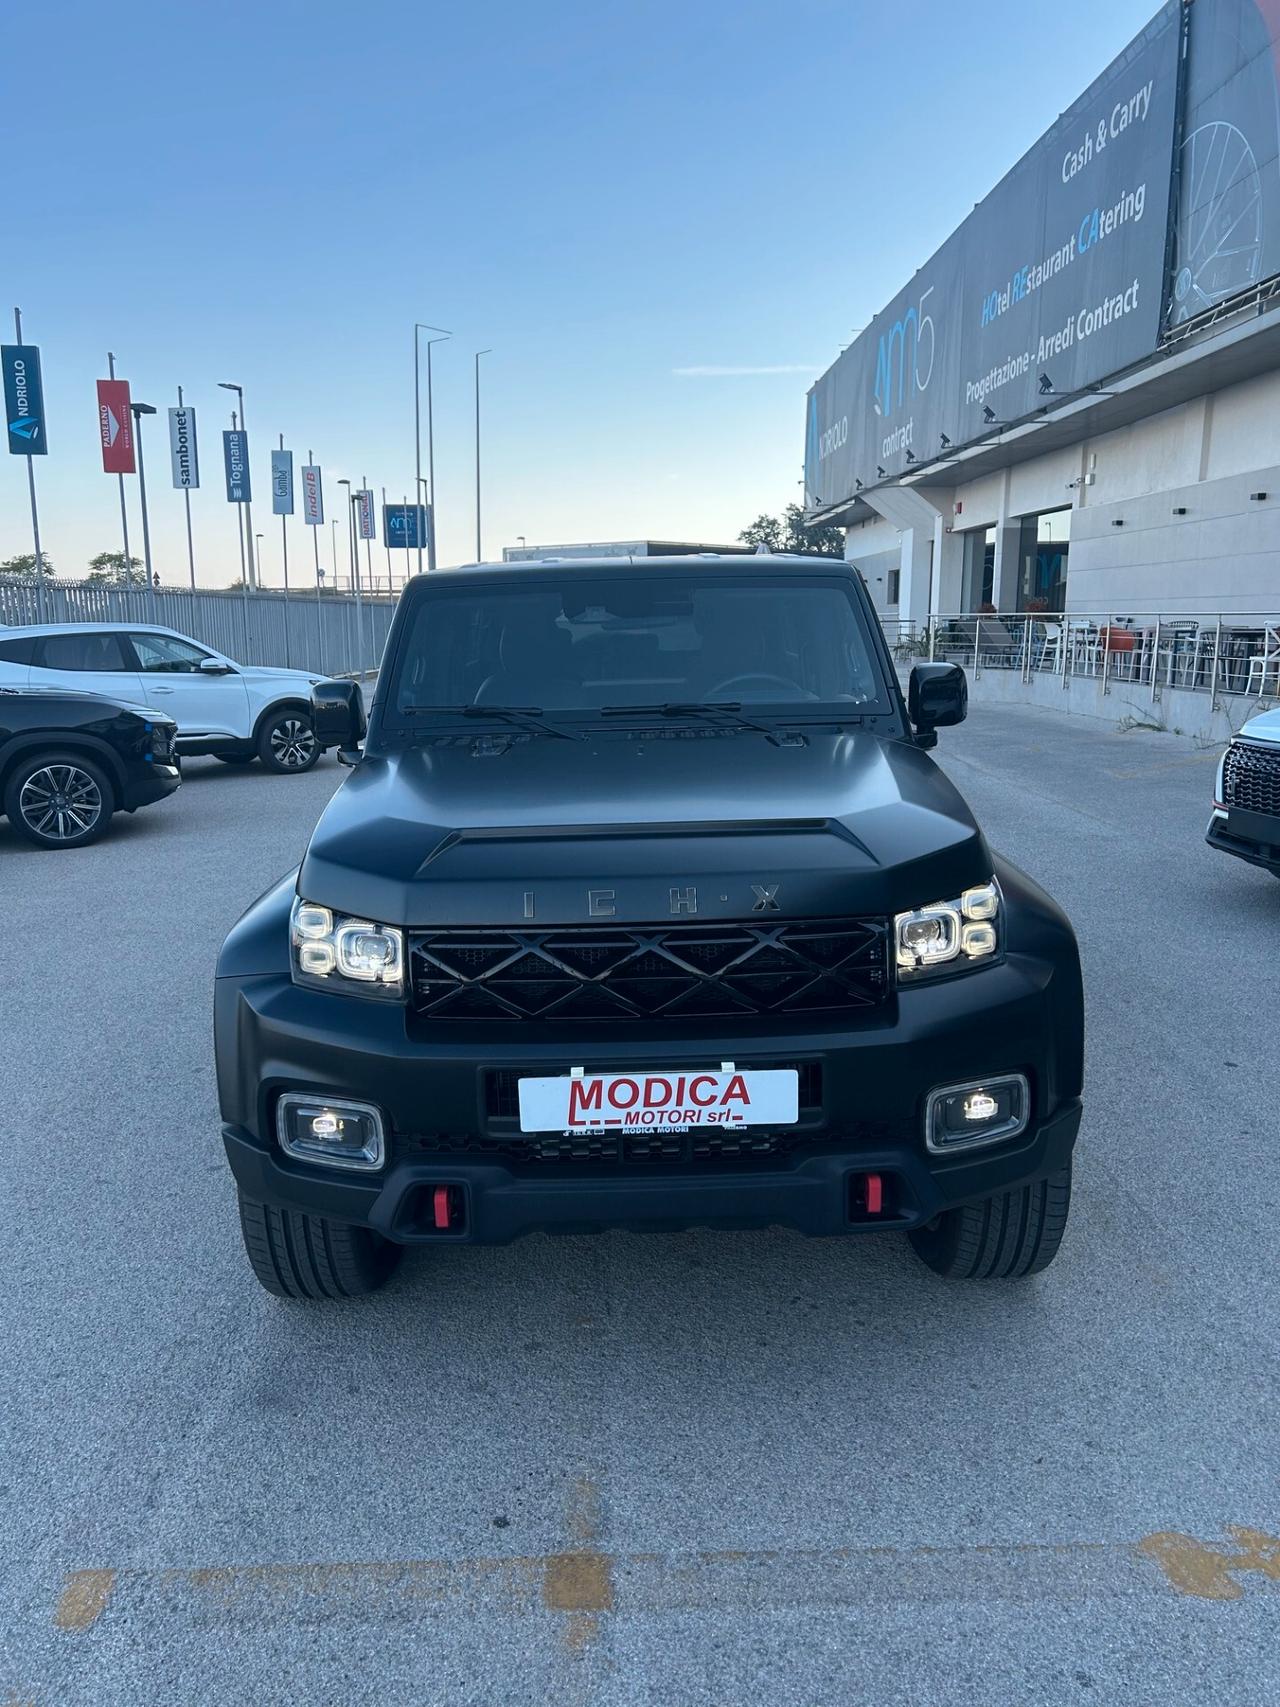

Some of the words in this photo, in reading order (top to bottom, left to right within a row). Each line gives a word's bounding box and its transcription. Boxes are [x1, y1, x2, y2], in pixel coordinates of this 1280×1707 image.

[1062, 133, 1093, 184] Cash
[1095, 118, 1108, 154] &
[1109, 79, 1154, 139] Carry
[981, 290, 1010, 328] HOtel
[1011, 235, 1076, 301] REstaurant
[1077, 182, 1146, 255] CAtering
[965, 352, 1030, 405] Progettazione
[1037, 316, 1075, 366] Arredi
[1076, 278, 1140, 342] Contract
[101, 404, 112, 449] PADERNO
[176, 411, 191, 485] sambonet
[882, 416, 914, 459] contract
[229, 433, 244, 487] Tognana
[568, 1075, 751, 1112] MODICA
[624, 1110, 702, 1126] MOTORI
[707, 1109, 731, 1123] srl
[622, 1127, 655, 1135] MODICA
[657, 1125, 689, 1134] MOTORI
